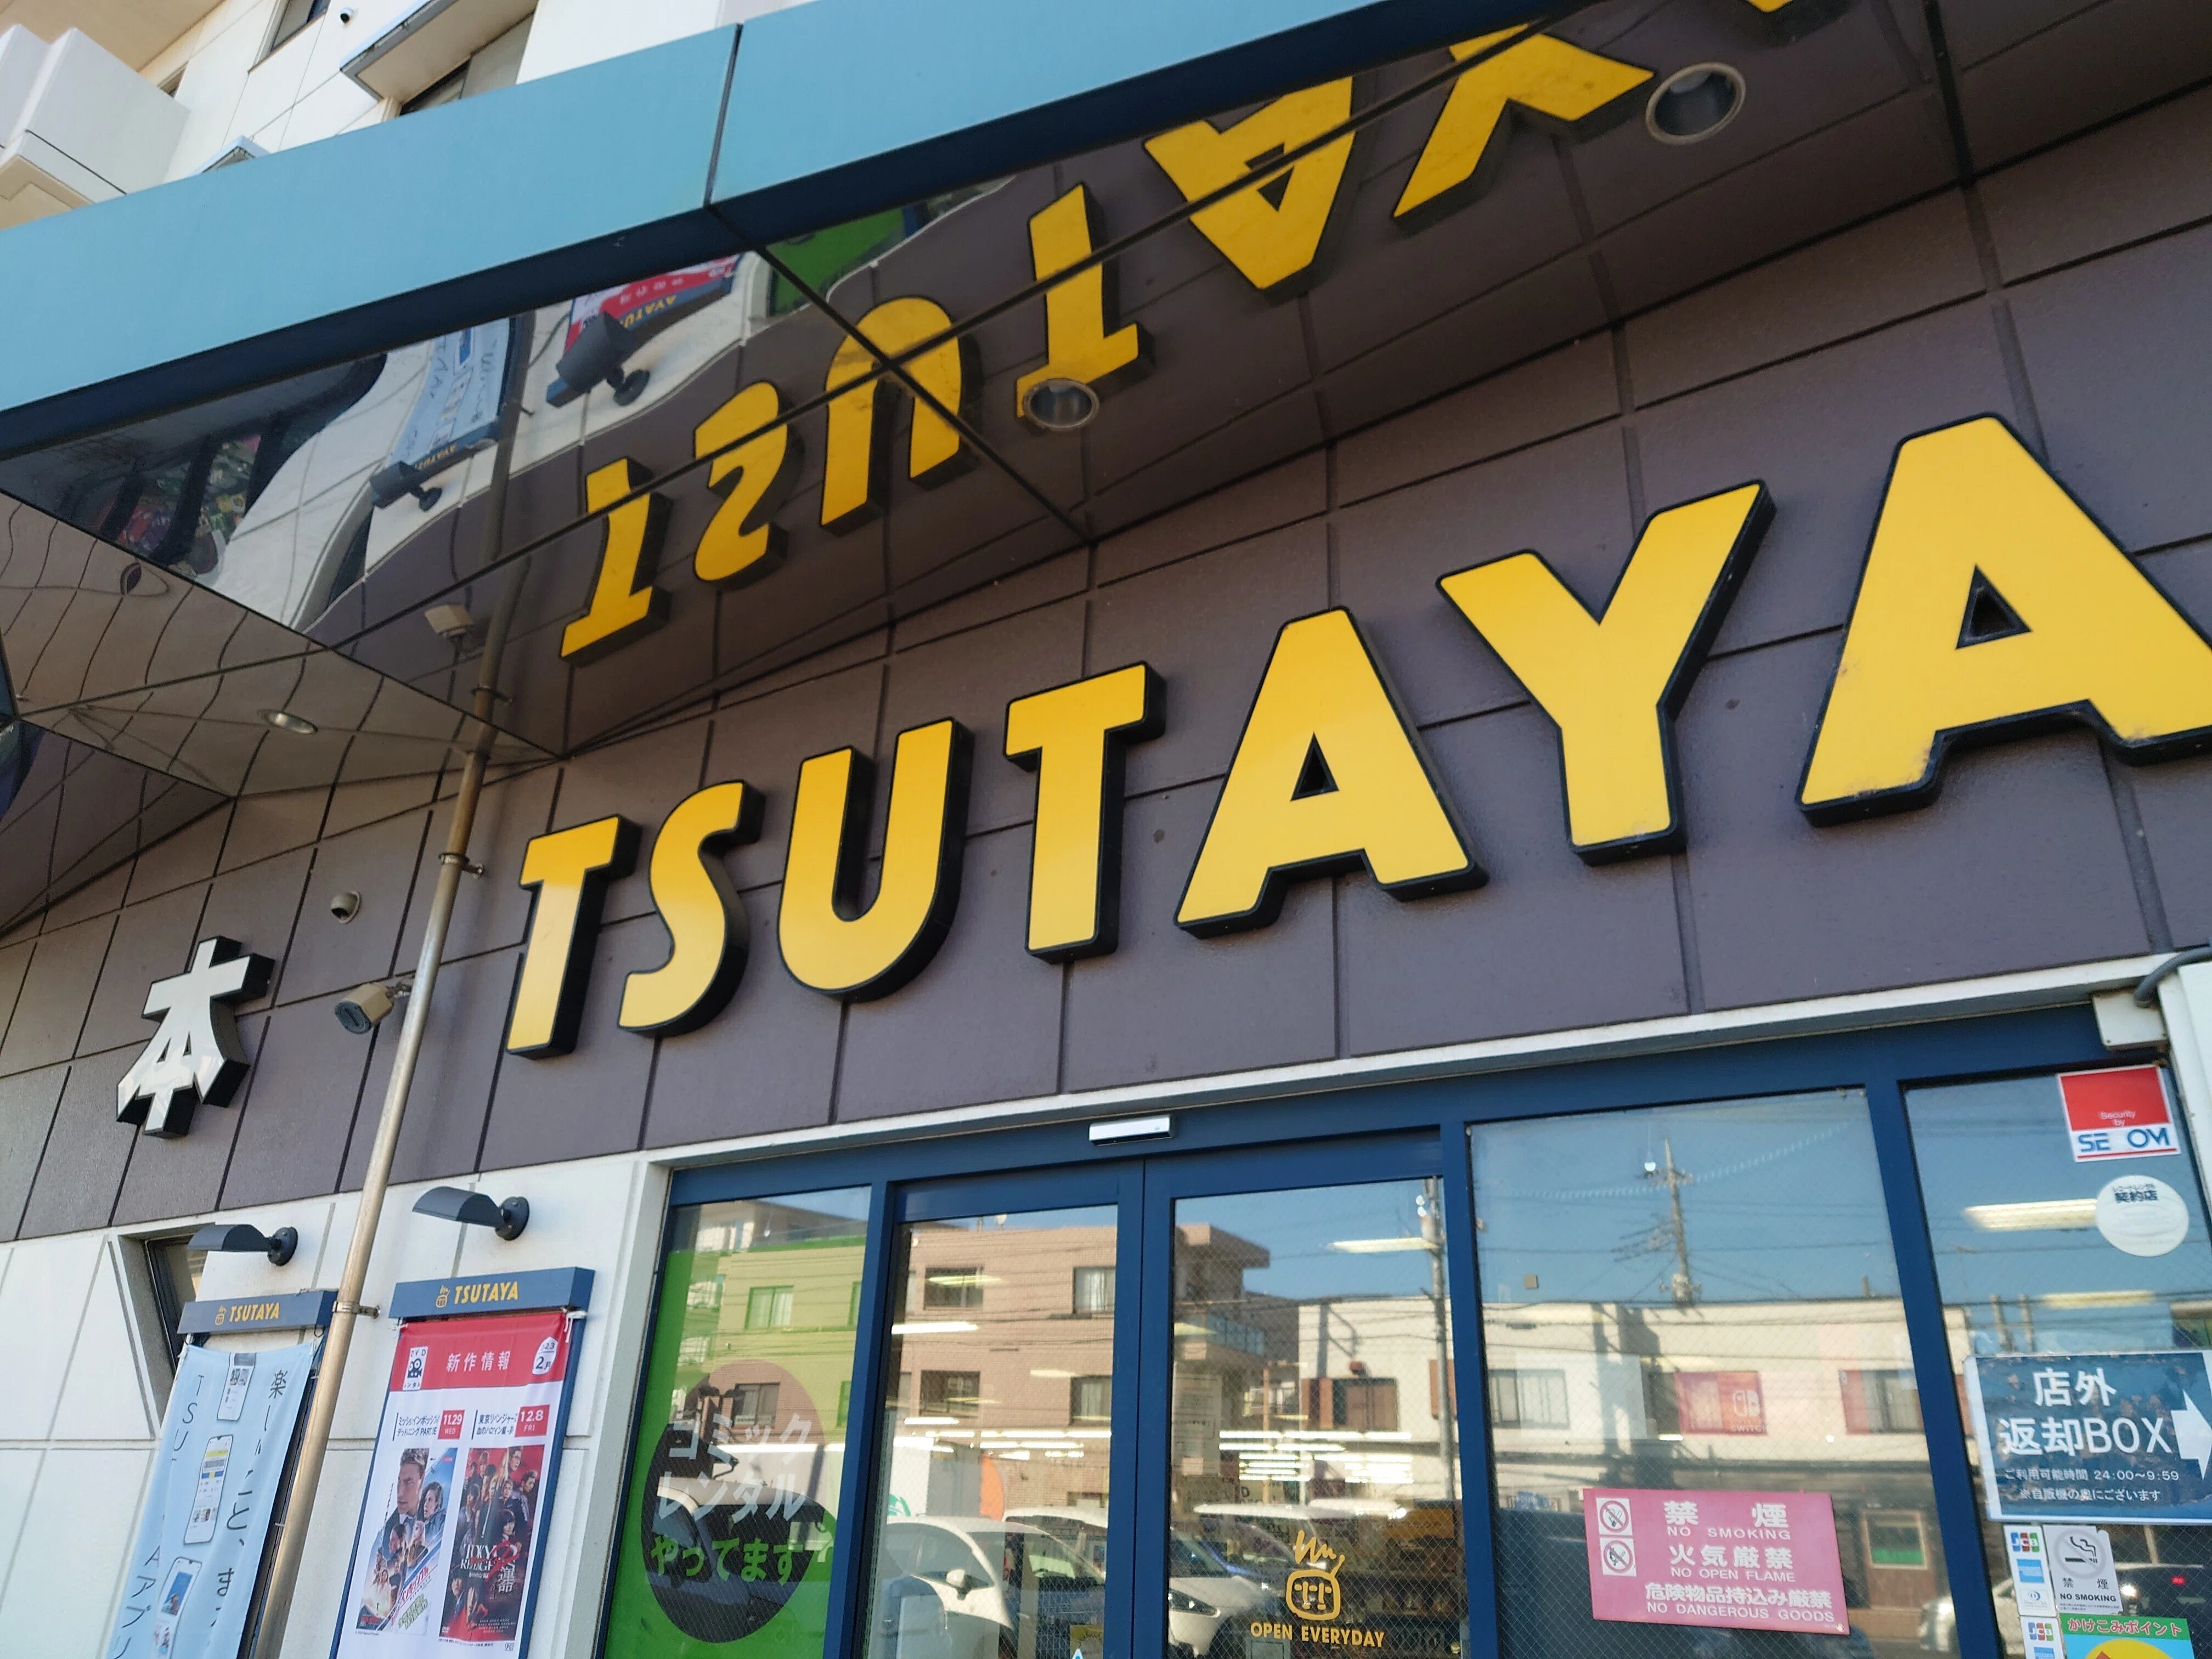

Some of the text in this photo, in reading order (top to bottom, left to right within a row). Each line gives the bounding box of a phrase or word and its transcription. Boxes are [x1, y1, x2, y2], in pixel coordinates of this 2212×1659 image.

[504, 414, 2212, 1057] TSUTAYA
[116, 937, 252, 1133] 本
[2100, 1110, 2136, 1120] Security
[2114, 1119, 2125, 1127] by
[2115, 1190, 2158, 1204] 契約店
[454, 1282, 518, 1305] TSUTAYA
[229, 1303, 280, 1322] TSUTAYA
[446, 1351, 511, 1372] 新作情報
[2033, 1367, 2117, 1407] 店外
[443, 1414, 462, 1425] 11.29
[521, 1409, 544, 1423] 12.8
[524, 1424, 535, 1432] FRI
[668, 1412, 813, 1465] コミック
[1998, 1417, 2172, 1457] 返却BOX
[657, 1471, 809, 1523] レンタル
[1667, 1526, 1792, 1541] NO SMOKING
[2011, 1532, 2040, 1553] JCB
[650, 1535, 804, 1585] やってます
[1669, 1544, 1793, 1570] 火気厳禁
[1671, 1567, 1796, 1582] NO OPEN FLAME
[2075, 1593, 2117, 1602] SMOKING
[1647, 1601, 1835, 1623] NO DANGEROUS GOODS
[1250, 1621, 1385, 1647] OPEN EVERYDAY
[2068, 1618, 2182, 1638] かけこみポイント
